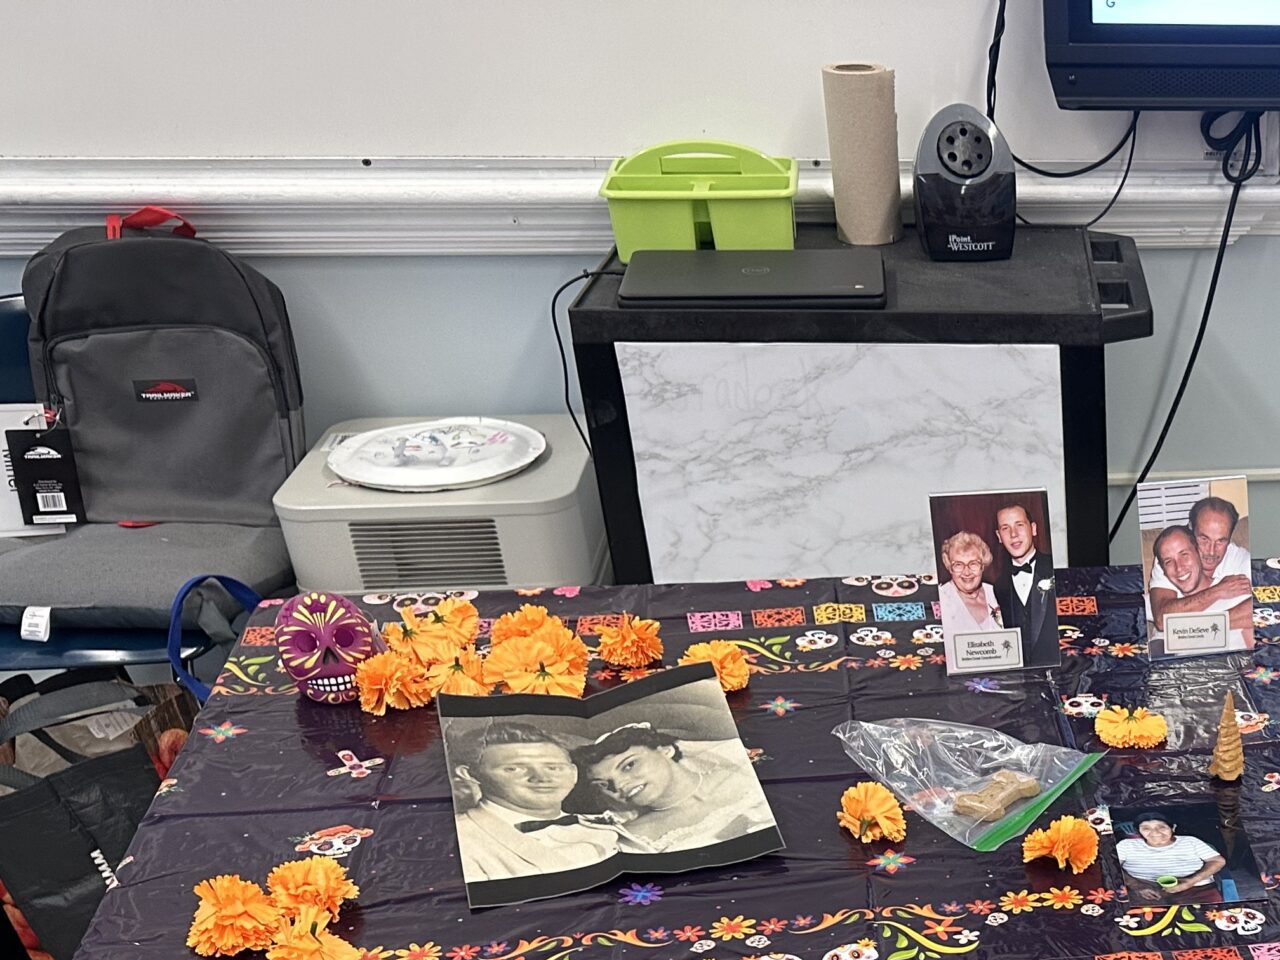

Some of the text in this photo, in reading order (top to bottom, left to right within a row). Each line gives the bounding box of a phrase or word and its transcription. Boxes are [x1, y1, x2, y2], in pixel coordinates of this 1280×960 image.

[948, 241, 995, 251] WESTCOTT
[1172, 627, 1189, 635] Kevin
[966, 648, 997, 656] Newcomb
